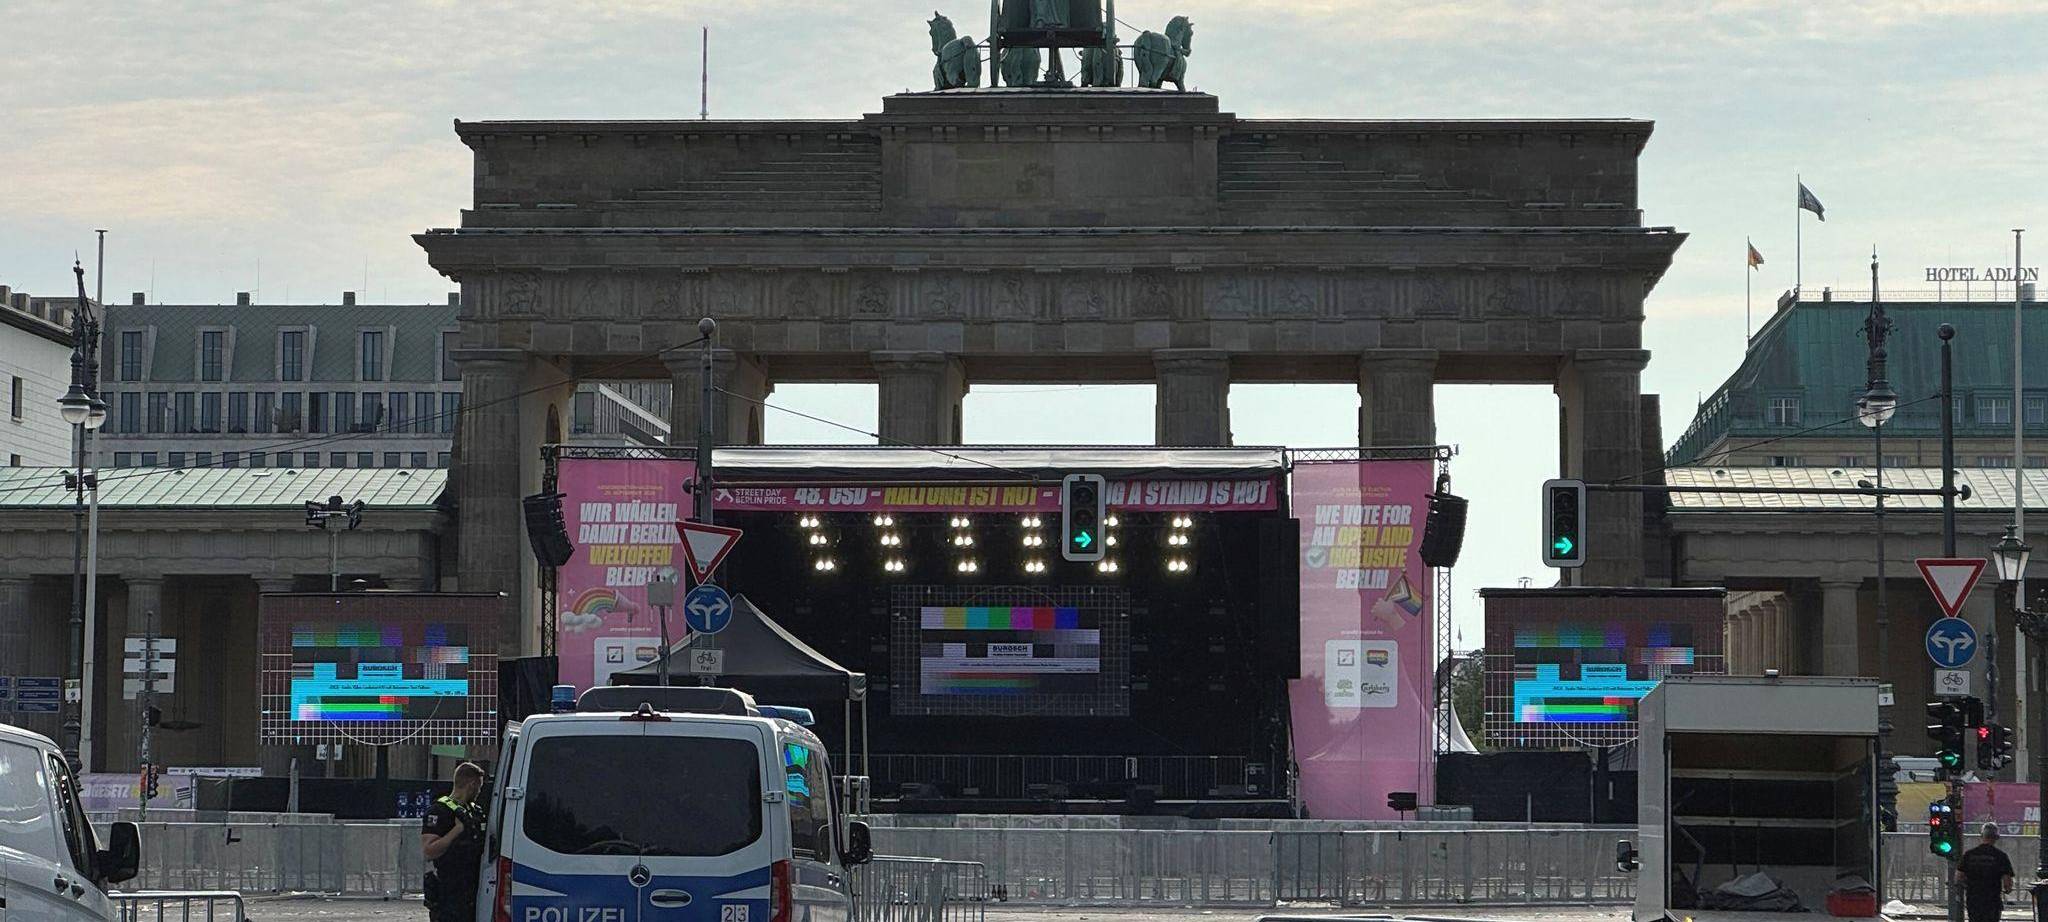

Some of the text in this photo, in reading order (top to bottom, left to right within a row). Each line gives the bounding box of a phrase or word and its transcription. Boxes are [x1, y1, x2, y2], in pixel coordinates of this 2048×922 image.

[1926, 267, 2039, 281] HOTEL ADLON
[735, 488, 781, 496] STREET DAY
[735, 496, 787, 505] BERLIN PRIDE
[829, 487, 868, 505] CSD
[884, 487, 966, 506] HALTUNG
[968, 487, 998, 506] IST
[1002, 487, 1037, 506] HOT
[1127, 481, 1141, 505] A
[1145, 481, 1208, 505] STAND
[1210, 481, 1231, 505] IS
[1233, 481, 1271, 505] HOT
[580, 502, 612, 522] WIR
[1315, 504, 1412, 525] WE VOTE FOR
[578, 523, 681, 543] DAMIT BERLIN
[1312, 526, 1413, 546] AN OPEN AND
[589, 545, 673, 565] WELTOFFEN
[1328, 548, 1407, 568] INCLUSIVE
[606, 566, 656, 586] BLEIBT
[1336, 569, 1389, 589] BERLIN
[1361, 682, 1390, 695] Carlsberg
[526, 905, 748, 922] POLIZEI 23
